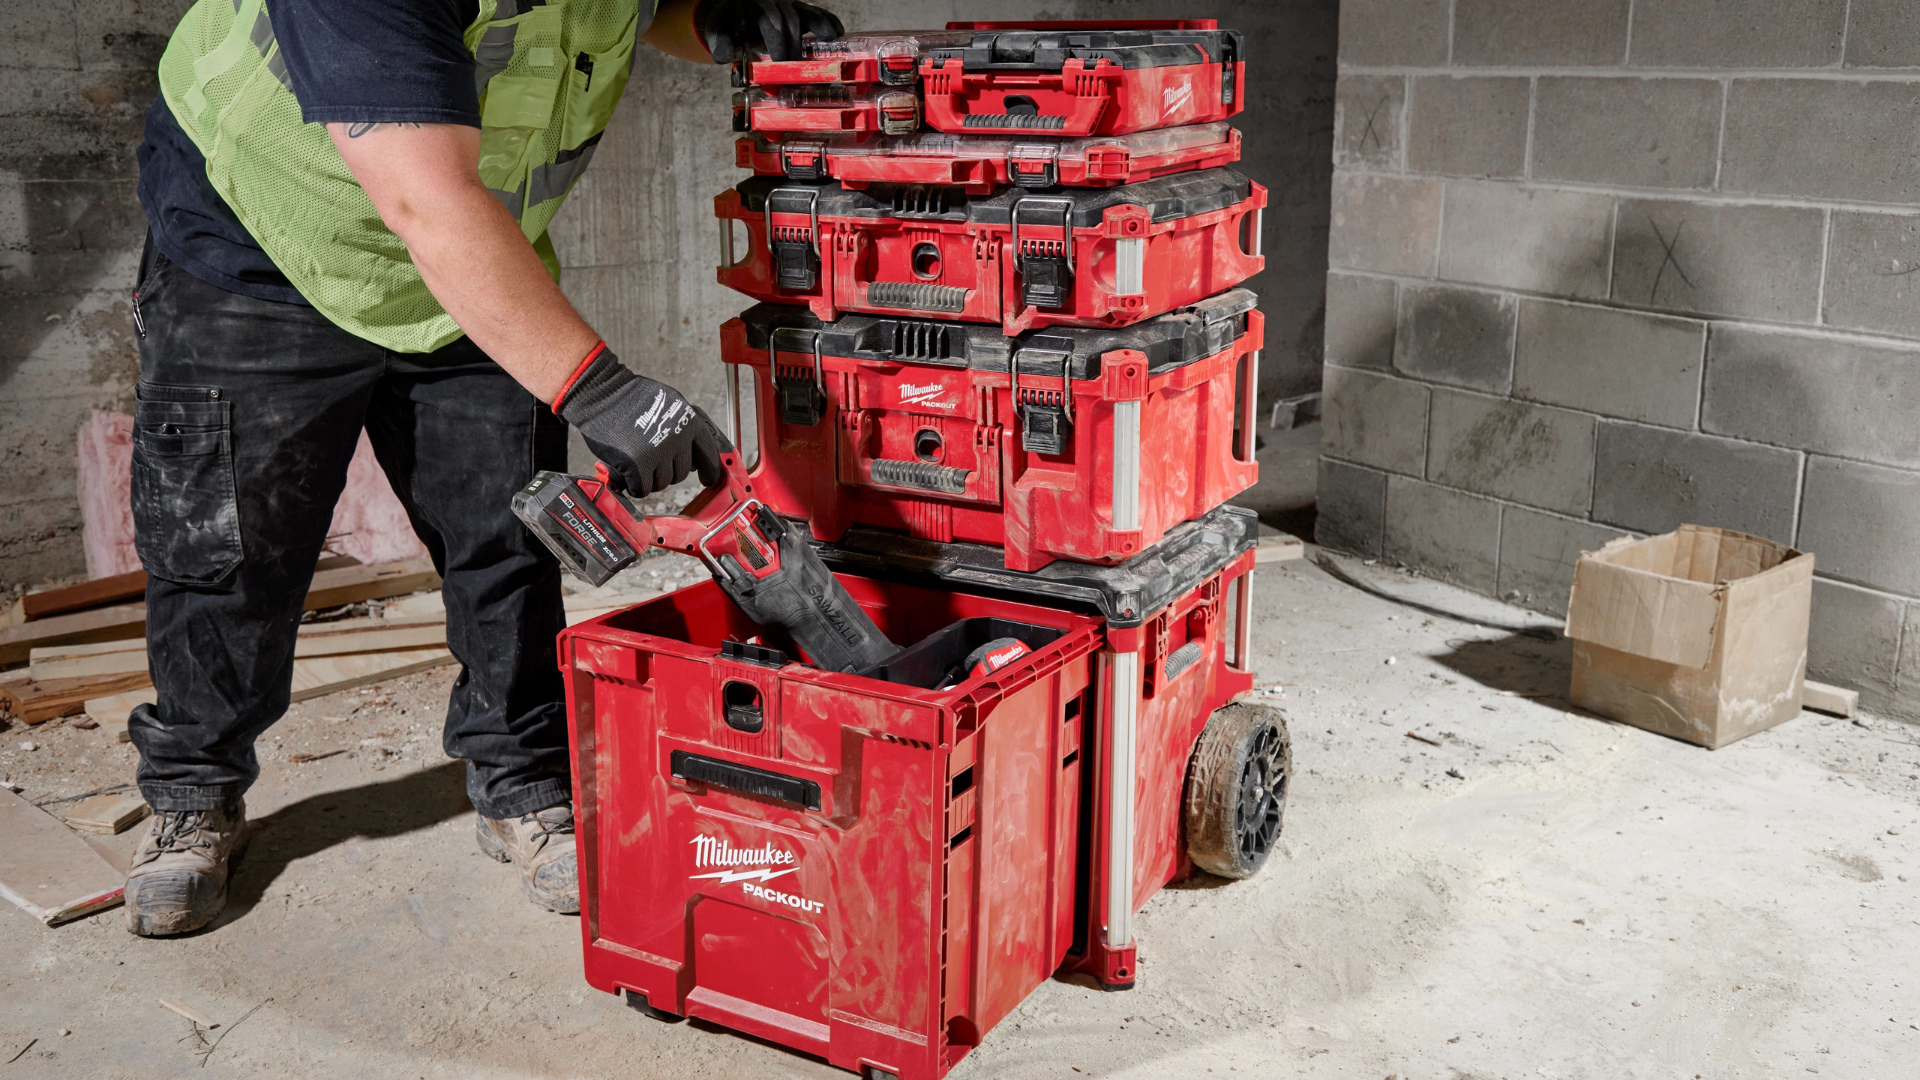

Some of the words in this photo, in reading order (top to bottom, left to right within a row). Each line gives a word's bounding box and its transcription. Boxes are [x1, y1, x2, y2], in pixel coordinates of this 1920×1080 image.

[898, 382, 943, 399] Milwaukee
[921, 400, 956, 409] PACKOUT
[634, 388, 664, 429] Milwaukee
[559, 493, 575, 509] M18
[572, 507, 607, 543] REDLITHIUM
[562, 511, 598, 547] FORGE
[602, 545, 618, 562] XC6.0
[808, 584, 856, 645] SAWZALL
[989, 646, 1024, 668] Milwaukee
[689, 833, 795, 868] Milwaukee
[743, 882, 824, 914] PACKOUT
